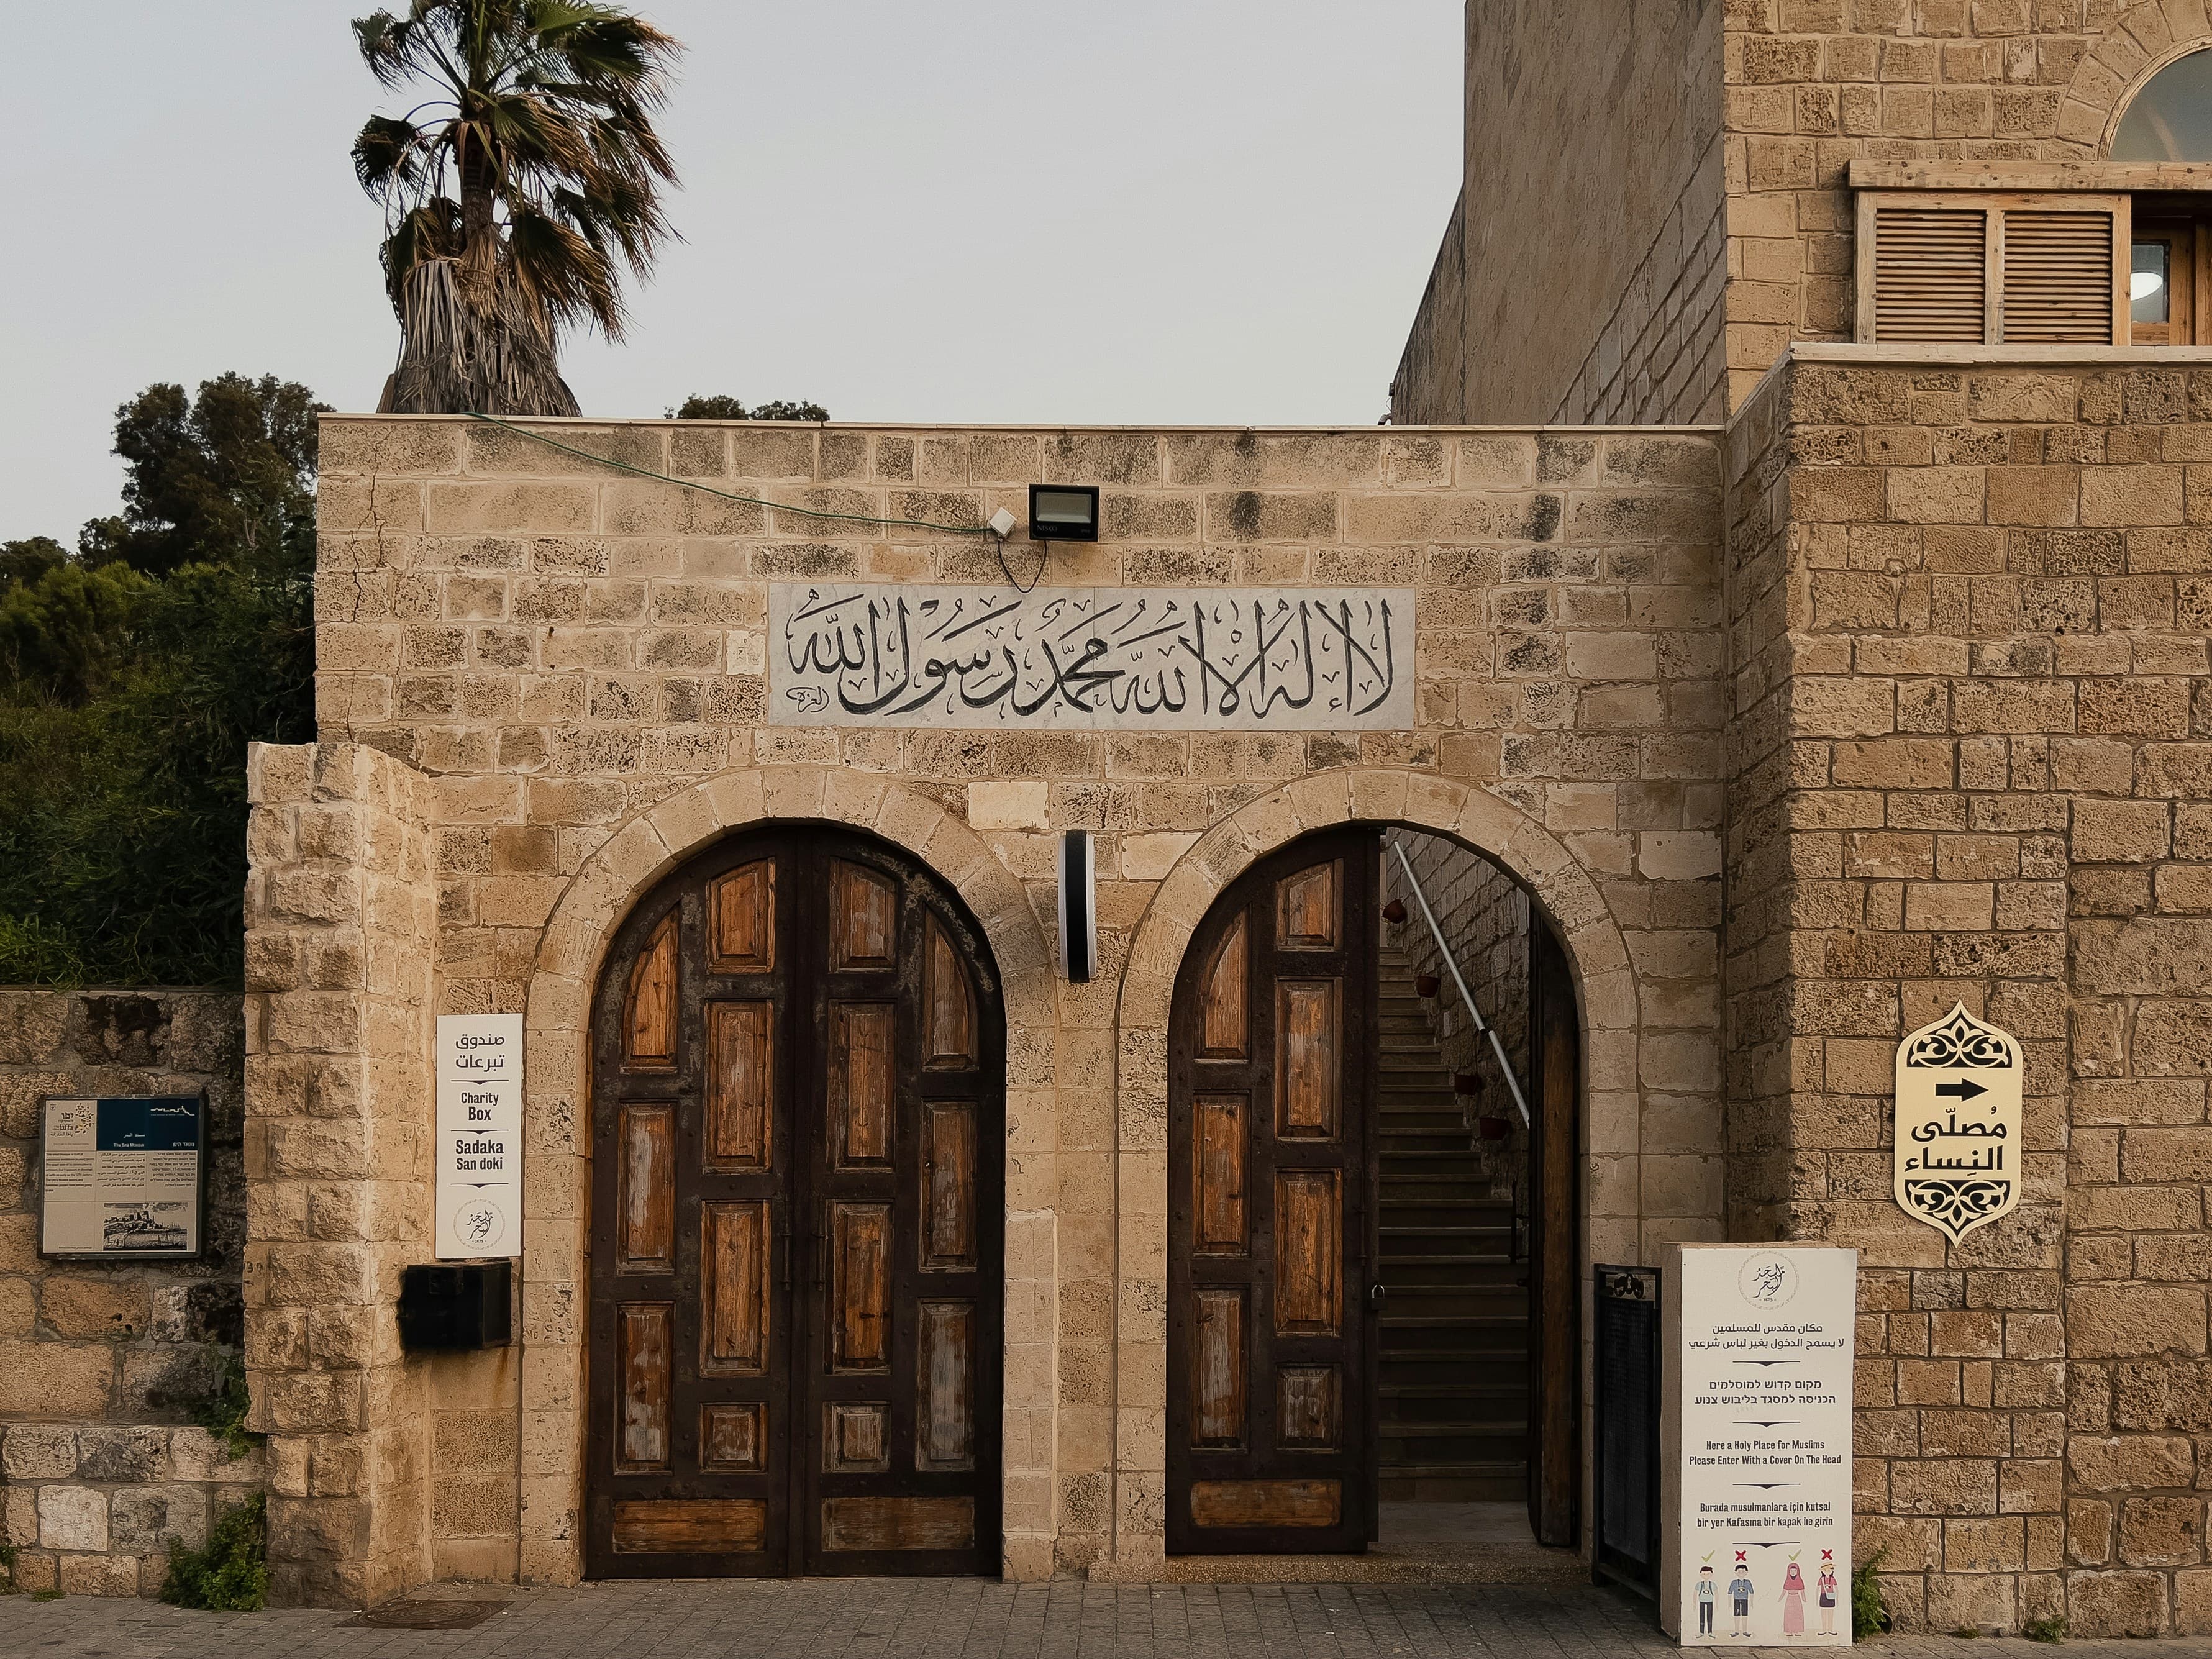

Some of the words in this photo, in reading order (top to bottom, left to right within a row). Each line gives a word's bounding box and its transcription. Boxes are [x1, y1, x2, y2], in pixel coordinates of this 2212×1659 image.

[1315, 598, 1393, 716] لا
[455, 1033, 505, 1050] صندوق
[455, 1054, 505, 1073] تبرعات
[461, 1092, 499, 1106] Charity
[468, 1106, 491, 1121] Box
[455, 1139, 504, 1155] Sadaka
[456, 1157, 476, 1170] San
[480, 1157, 503, 1170] doki
[1713, 1323, 1761, 1335] للمسلمين
[1763, 1324, 1796, 1335] مقدس
[1798, 1323, 1823, 1335] مكان
[1688, 1337, 1721, 1350] شرعي
[1723, 1338, 1747, 1350] لباس
[1748, 1338, 1768, 1350] بغير
[1770, 1338, 1803, 1350] الدخول
[1805, 1339, 1836, 1350] يسمح
[1837, 1338, 1844, 1347] لا
[1709, 1379, 1761, 1389] למוסלמים
[1764, 1381, 1791, 1391] קדוש
[1795, 1381, 1822, 1391] מקום
[1695, 1396, 1718, 1404] צנוע
[1721, 1394, 1758, 1404] בליבוש
[1760, 1394, 1795, 1404] למסגד
[1798, 1395, 1836, 1404] הכניסה
[1706, 1440, 1725, 1450] Here
[1727, 1442, 1732, 1450] a
[1734, 1440, 1752, 1452] Holy
[1753, 1440, 1775, 1450] Place
[1777, 1440, 1790, 1450] for
[1791, 1440, 1824, 1450] Muslims
[1689, 1455, 1716, 1465] Please
[1718, 1455, 1740, 1465] Enter
[1741, 1455, 1760, 1465] With
[1770, 1455, 1793, 1465] Cover
[1794, 1455, 1805, 1465] On
[1806, 1455, 1820, 1465] The
[1822, 1454, 1841, 1464] Head
[1700, 1502, 1729, 1512] Burada
[1731, 1502, 1788, 1512] musulmanlara
[1790, 1502, 1804, 1514] için
[1806, 1501, 1831, 1511] kutsal
[1697, 1517, 1709, 1527] bir
[1710, 1520, 1724, 1529] yer
[1726, 1517, 1762, 1527] Kafasına
[1764, 1517, 1776, 1527] bir
[1777, 1517, 1802, 1529] kapak
[1814, 1516, 1833, 1528] girin
